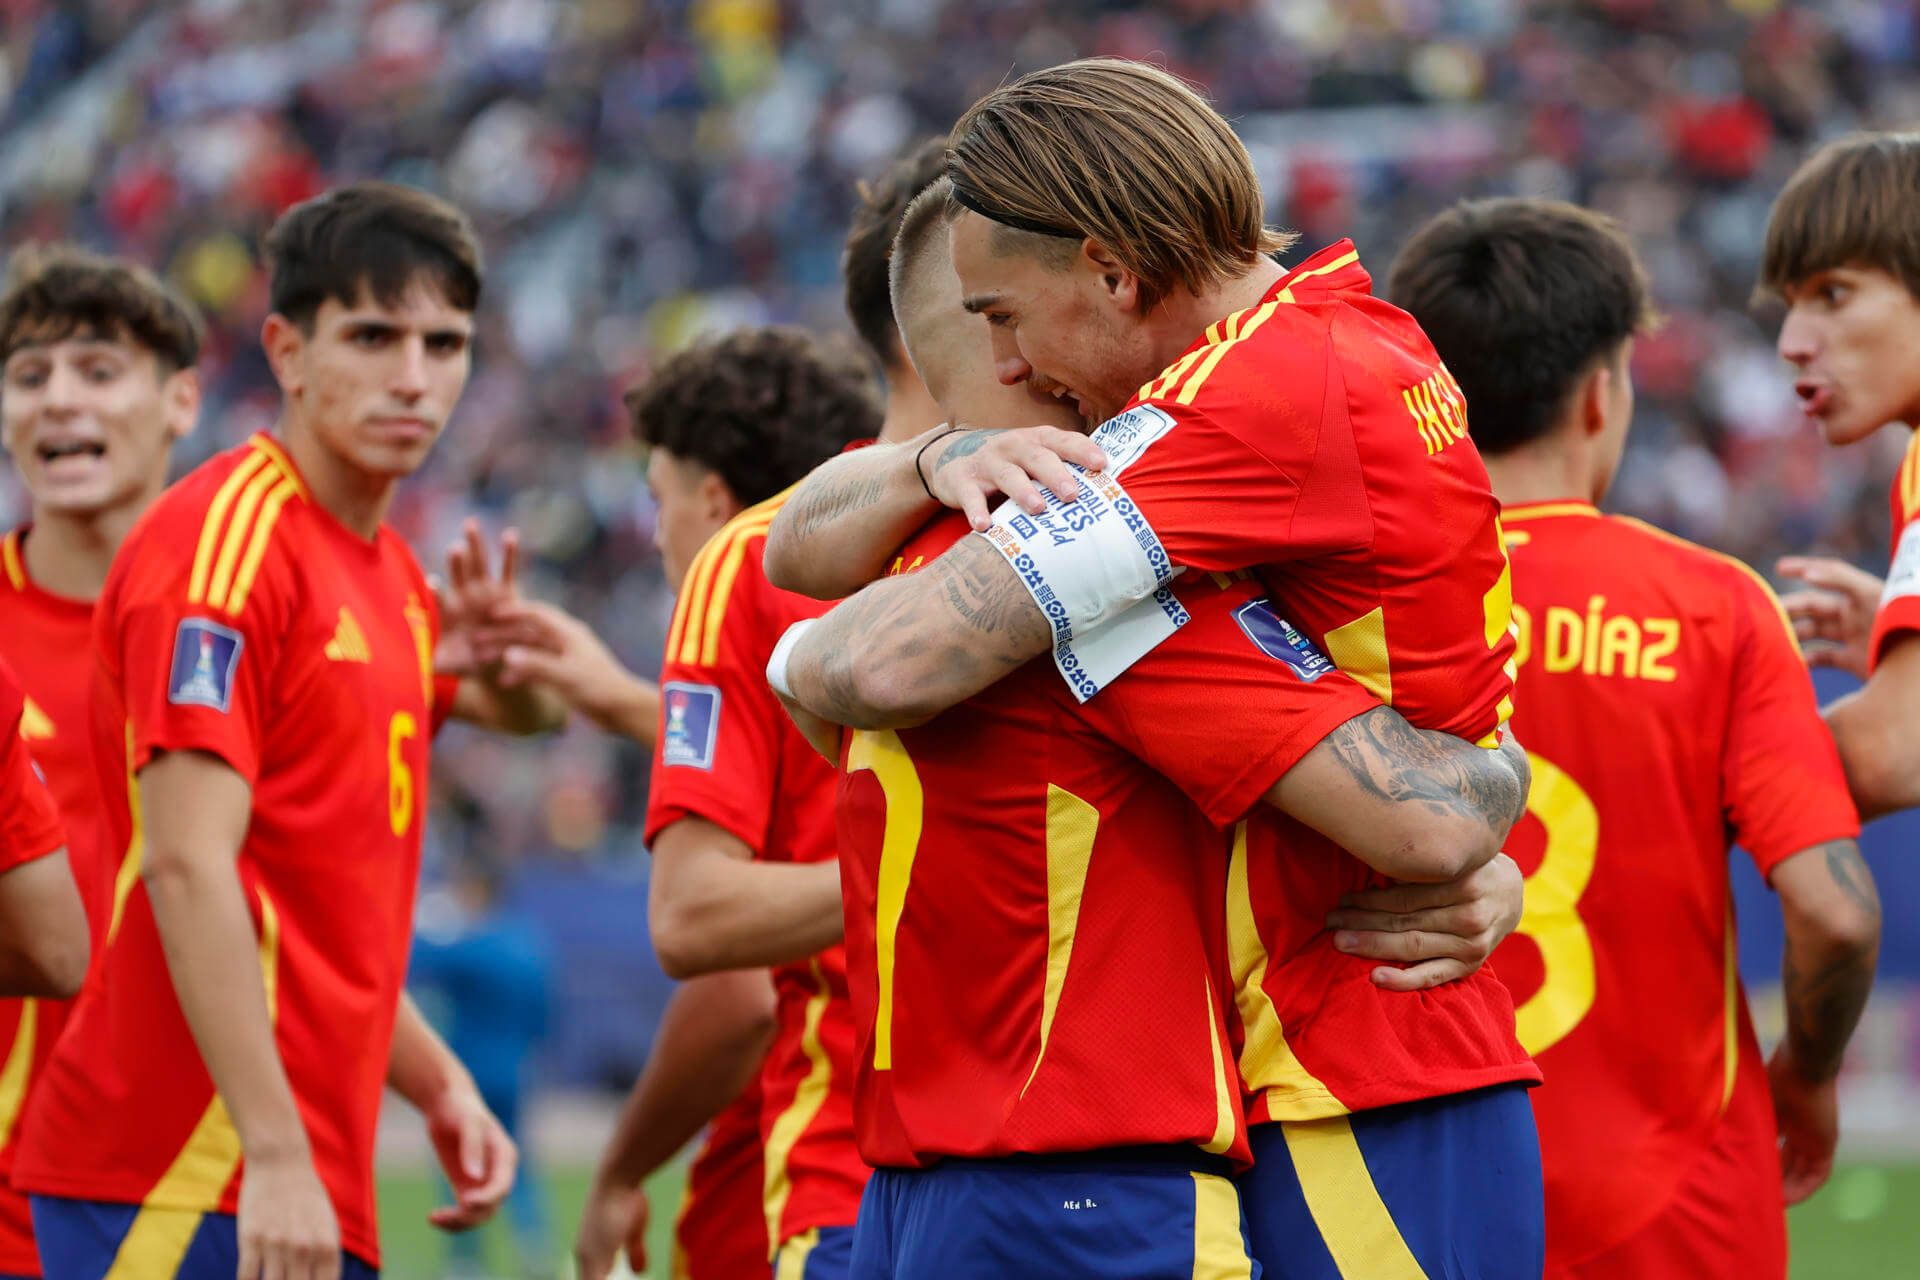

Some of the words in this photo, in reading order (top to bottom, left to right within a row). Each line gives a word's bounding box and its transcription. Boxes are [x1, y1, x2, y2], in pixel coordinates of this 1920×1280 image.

[1012, 516, 1035, 538] FIFA
[1544, 594, 1680, 682] DÍAZ
[388, 709, 417, 839] 6
